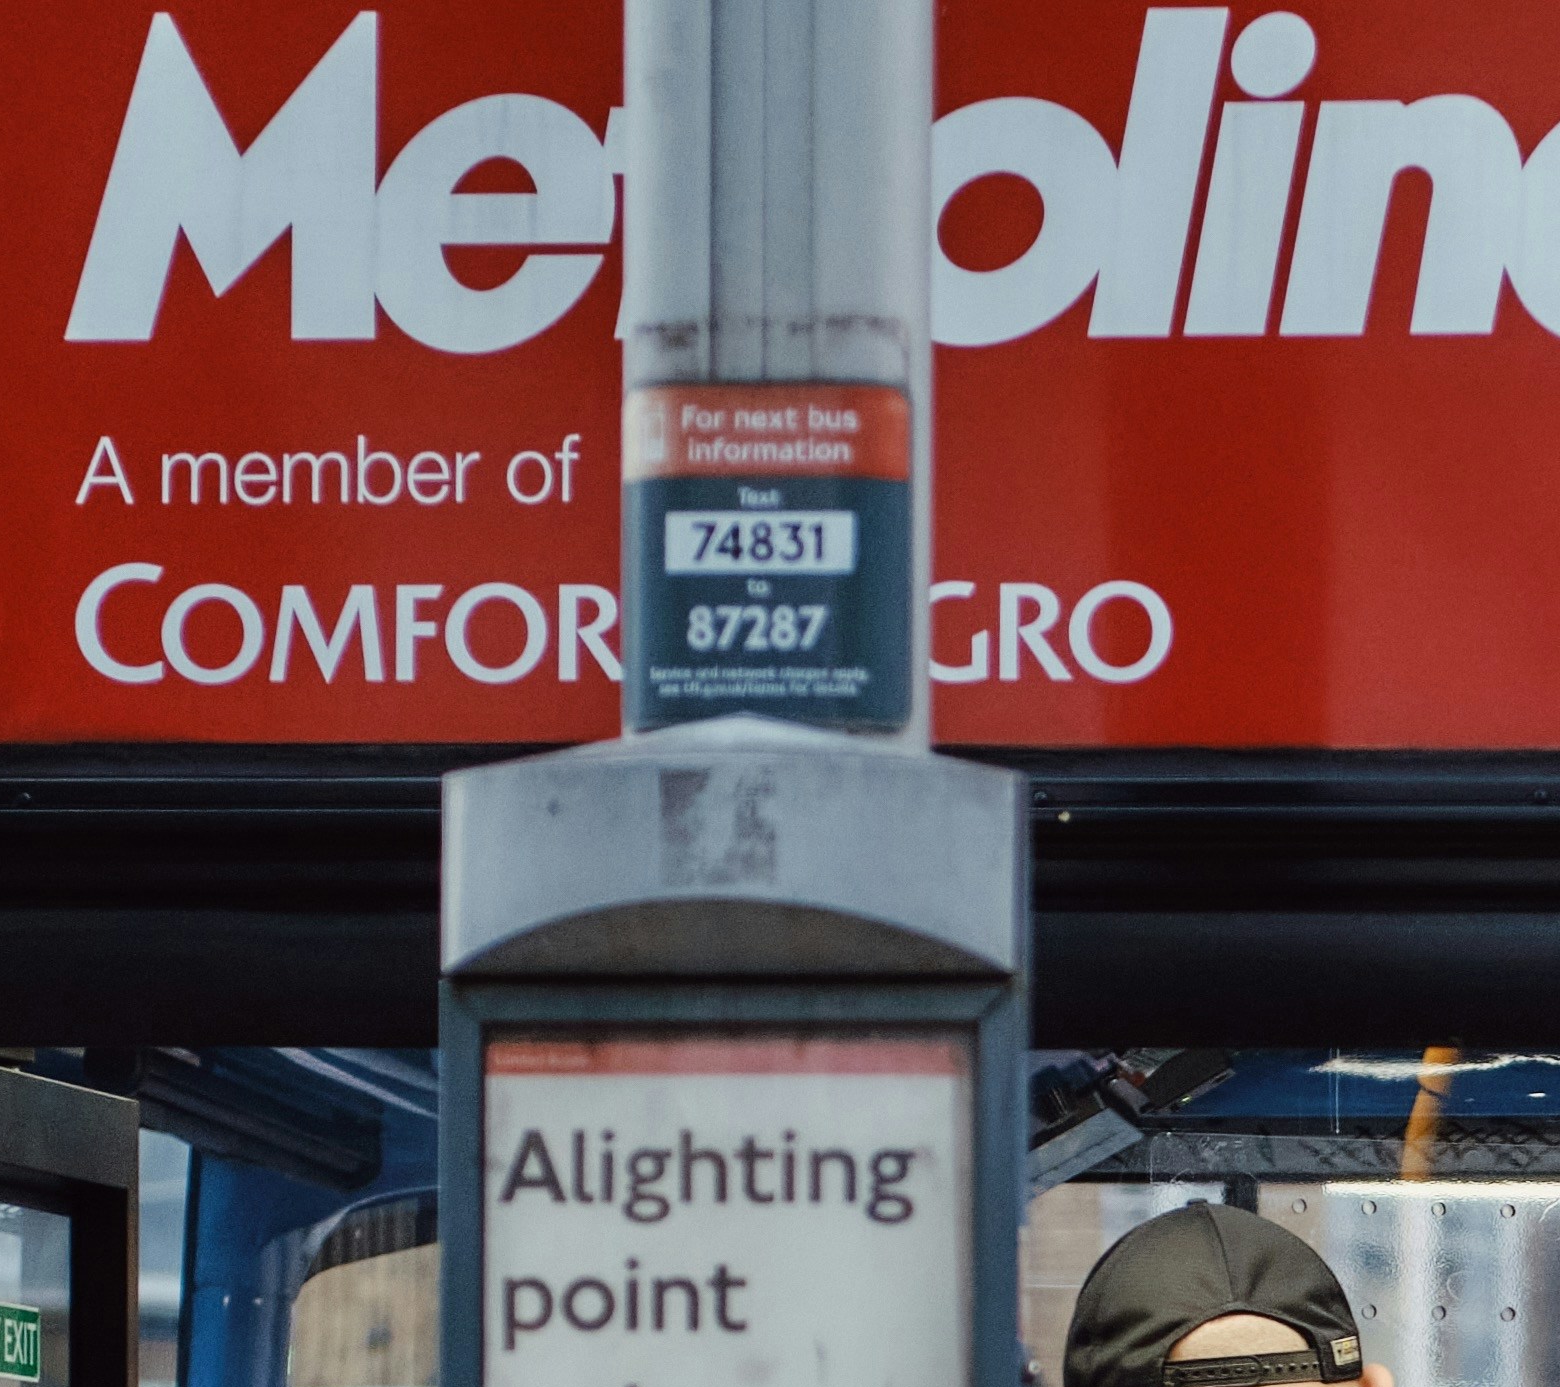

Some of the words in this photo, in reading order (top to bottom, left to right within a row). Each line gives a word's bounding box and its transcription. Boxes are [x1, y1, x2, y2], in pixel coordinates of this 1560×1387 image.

[681, 405, 725, 429] For
[734, 406, 798, 429] next
[807, 405, 859, 431] bus
[75, 436, 135, 505] A
[161, 435, 484, 506] member
[506, 433, 581, 505] of
[687, 436, 852, 463] information
[738, 486, 780, 507] Text
[693, 522, 825, 563] 74831
[746, 579, 770, 597] to
[686, 605, 829, 651] 87287
[498, 1128, 918, 1226] Alighting
[500, 1257, 750, 1352] point
[3, 1317, 38, 1366] EXIT
